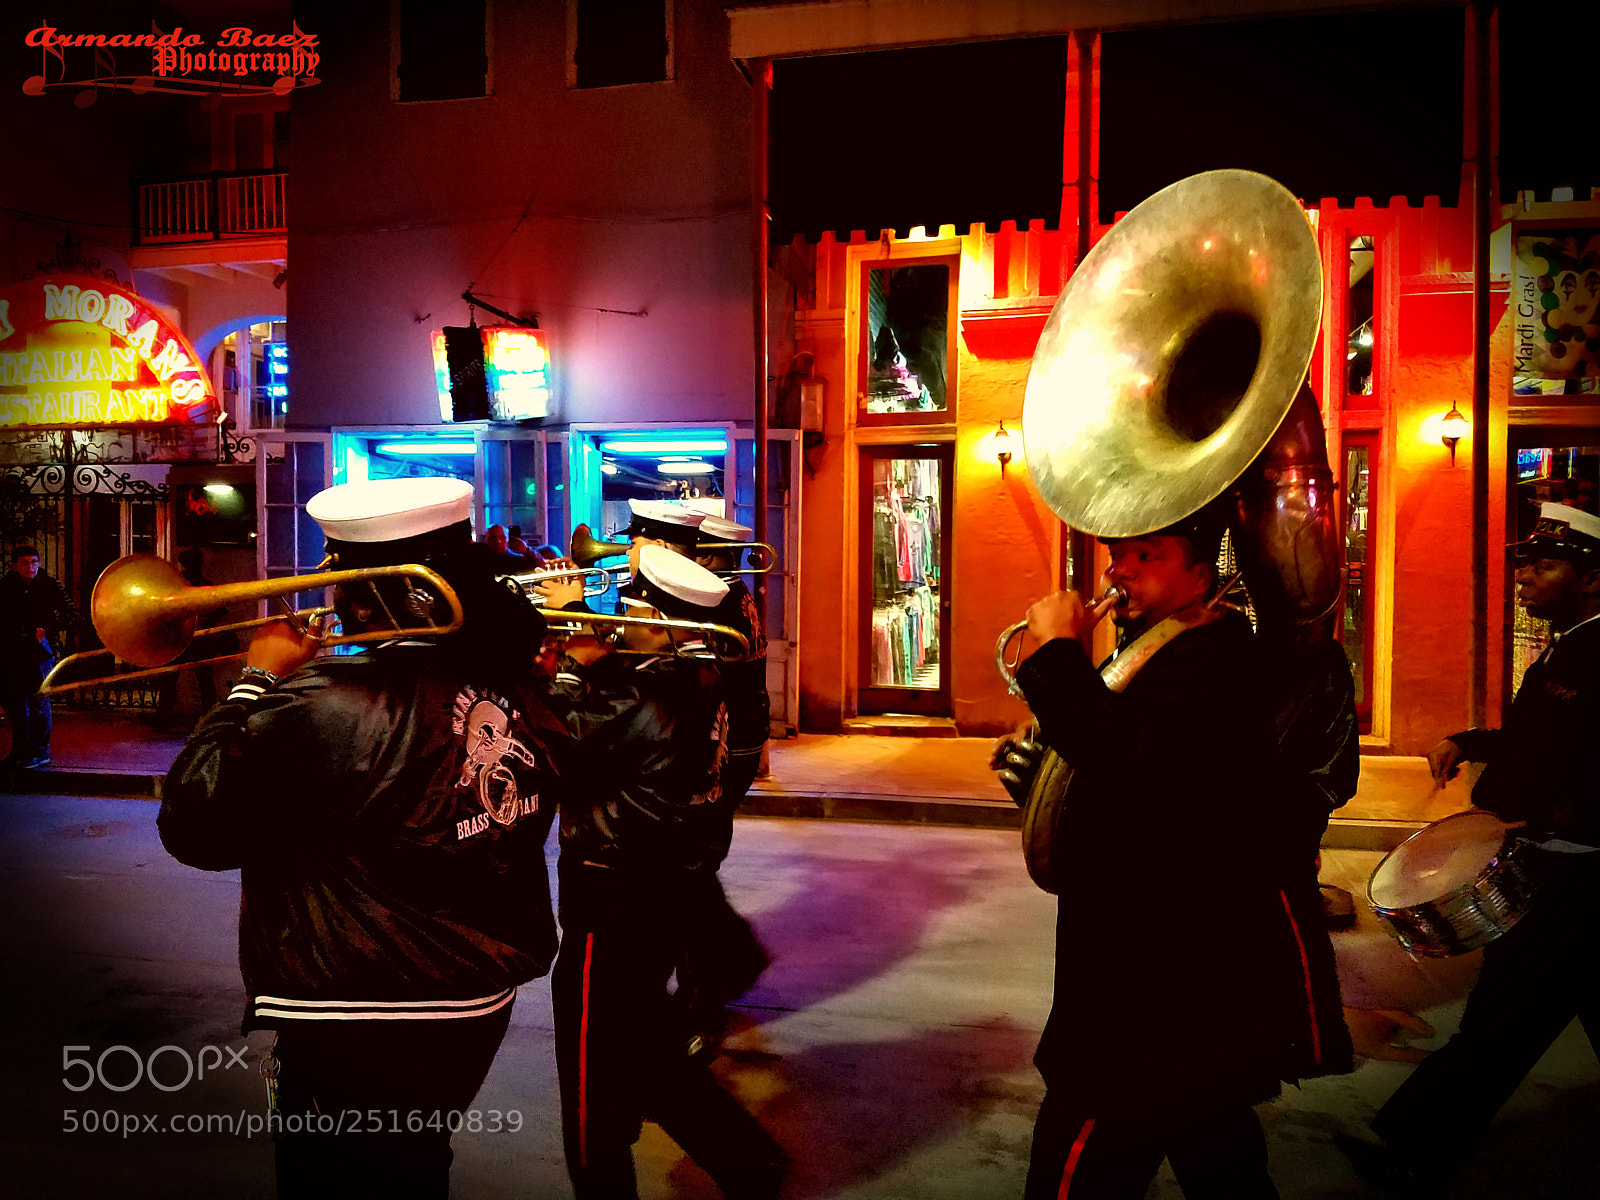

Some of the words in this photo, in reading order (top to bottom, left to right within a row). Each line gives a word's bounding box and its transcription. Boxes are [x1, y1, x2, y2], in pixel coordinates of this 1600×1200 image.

[1518, 275, 1535, 318] Gras!
[1515, 324, 1535, 373] Mardi
[0, 390, 169, 424] STAURANT
[456, 812, 490, 840] BRASS
